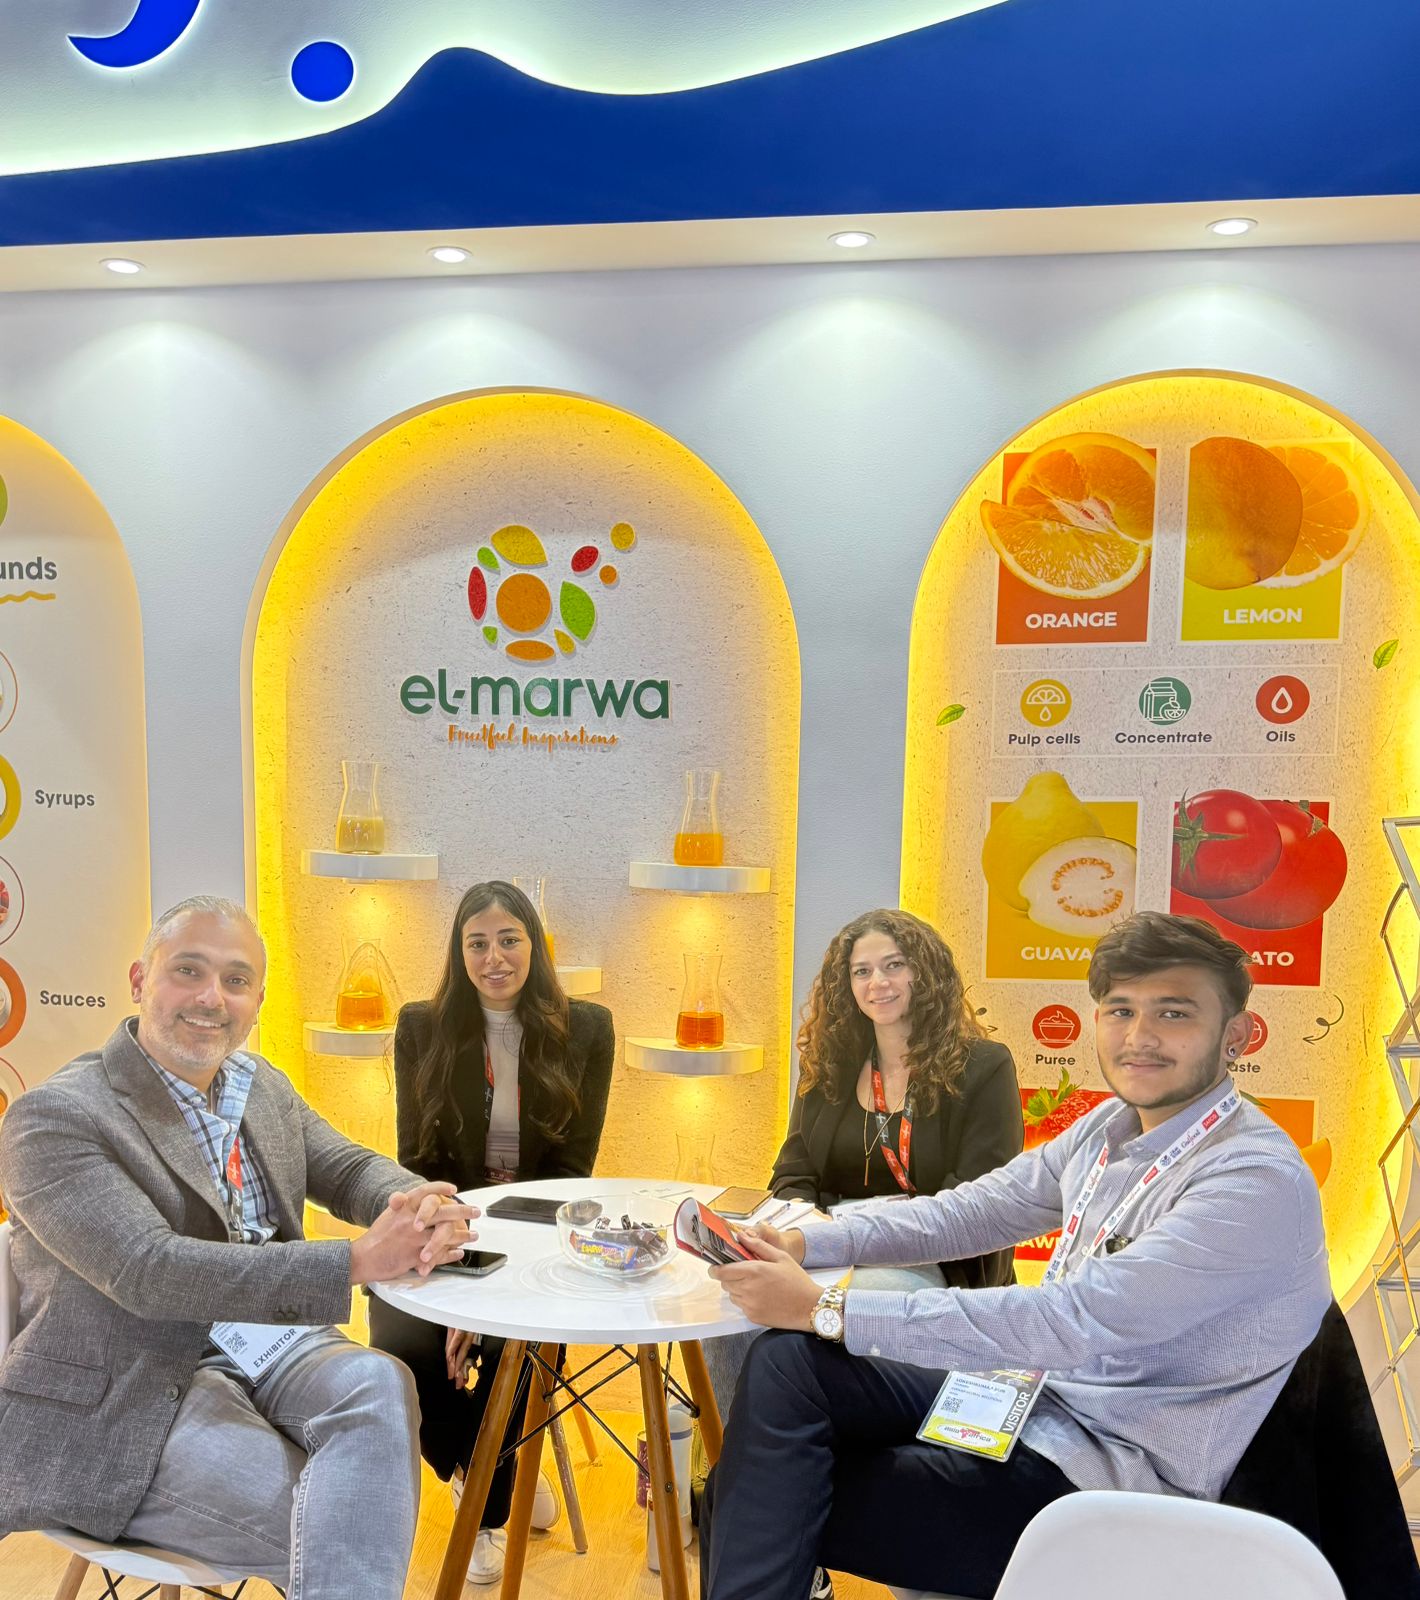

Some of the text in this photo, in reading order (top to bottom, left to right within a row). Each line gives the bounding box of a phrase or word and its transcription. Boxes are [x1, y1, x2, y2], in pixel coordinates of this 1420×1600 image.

[1025, 611, 1118, 629] ORANGE
[1223, 608, 1303, 624] LEMON
[400, 668, 669, 720] el-marwa
[522, 727, 618, 752] Inspirations
[1008, 732, 1081, 747] Pulp cells
[1114, 731, 1213, 744] Concentrate
[1266, 730, 1296, 742] Oils
[35, 789, 95, 808] Syrups
[1021, 946, 1094, 961] GUAVA
[1251, 951, 1294, 967] ATO
[40, 990, 106, 1008] Sauces
[1035, 1053, 1076, 1066] Puree
[1227, 1061, 1261, 1074] aste
[1181, 1128, 1201, 1149] Gulfood
[253, 1327, 297, 1368] EXHIBITOR
[1003, 1391, 1031, 1432] VISITOR
